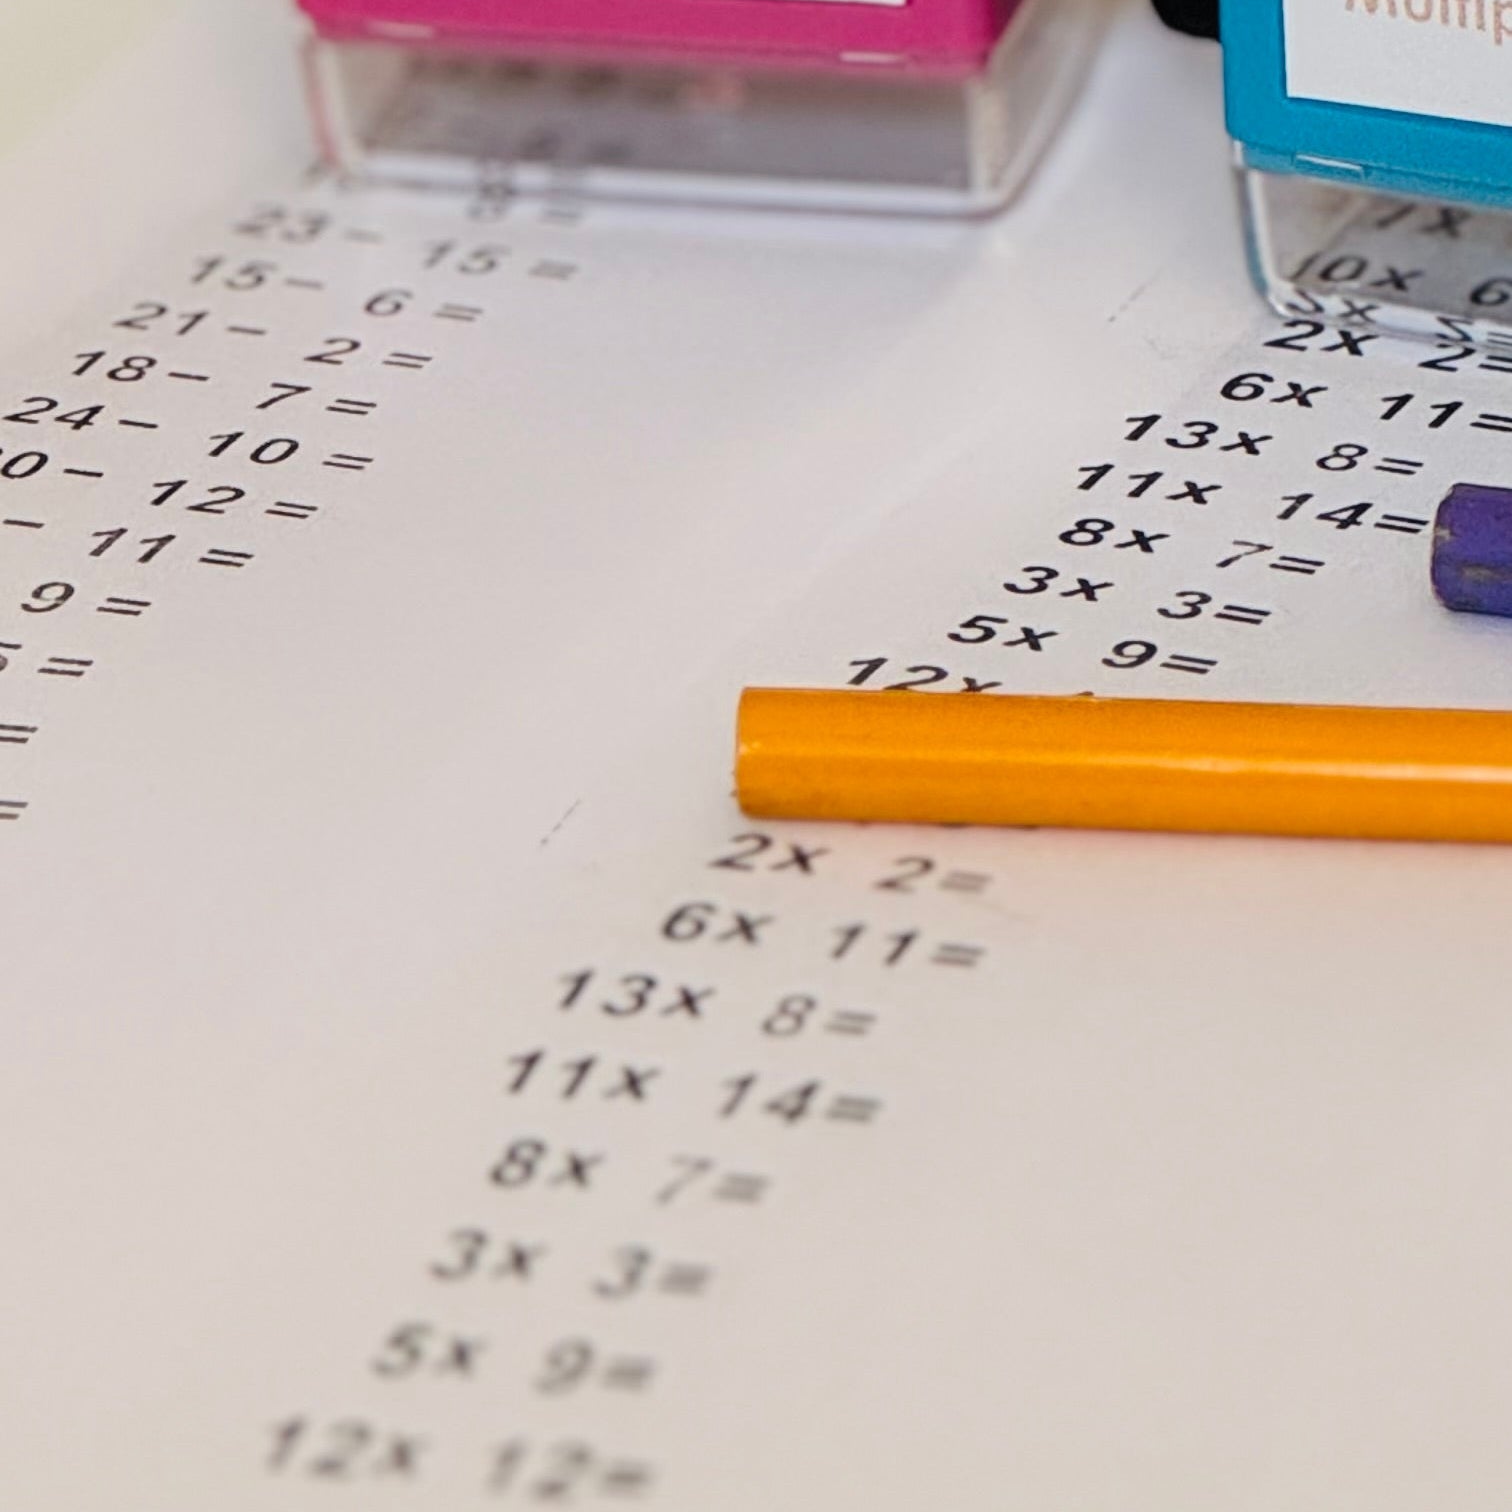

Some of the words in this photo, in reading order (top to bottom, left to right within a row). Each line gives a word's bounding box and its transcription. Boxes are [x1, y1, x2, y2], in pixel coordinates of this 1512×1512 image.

[1263, 319, 1379, 356] 2x
[1219, 372, 1329, 409] 6x
[207, 431, 301, 465] 10
[1123, 413, 1274, 457] 13x
[1315, 442, 1425, 477] 8=
[149, 478, 247, 516] 12
[1076, 462, 1223, 506] 11x
[1275, 492, 1431, 535] 14=
[88, 527, 178, 566] 11
[1057, 518, 1171, 555] 8x
[1215, 539, 1326, 576] 7=
[1002, 565, 1115, 603] 3x
[1156, 590, 1273, 626] 3=
[946, 614, 1060, 653] 5x
[1100, 639, 1219, 676] 9=
[707, 831, 830, 877] 2x
[871, 854, 993, 895] 2=
[658, 901, 774, 947] 6x
[827, 920, 987, 970] 11=
[556, 967, 716, 1021] 13x
[759, 993, 878, 1039] 8=
[504, 1047, 662, 1104] 11x
[717, 1071, 884, 1128] 14=
[486, 1136, 606, 1191] 8x
[427, 1226, 546, 1283] 3x
